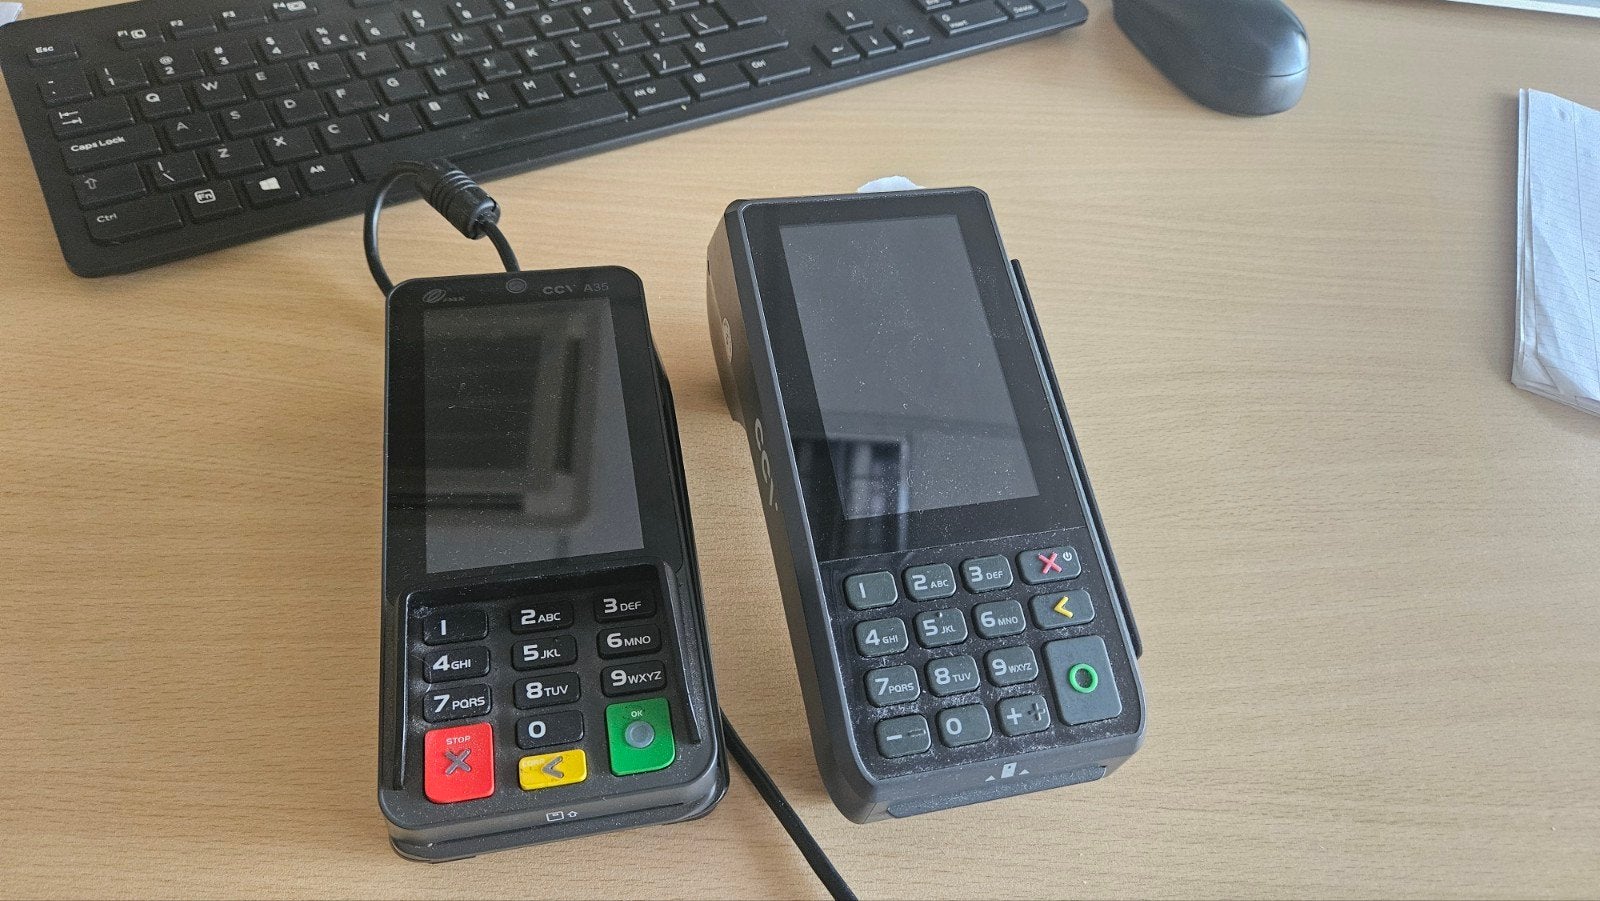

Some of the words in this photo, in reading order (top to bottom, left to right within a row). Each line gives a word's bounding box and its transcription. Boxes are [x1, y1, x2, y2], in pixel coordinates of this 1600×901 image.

[540, 14, 553, 24] O
[451, 32, 464, 43] U
[405, 41, 416, 51] Y
[569, 39, 581, 48] L
[356, 51, 367, 61] T
[526, 47, 538, 57] K
[165, 66, 175, 74] 2
[307, 61, 320, 71] R
[255, 71, 267, 81] E
[202, 80, 218, 91] W
[523, 80, 537, 90] M
[145, 93, 161, 102] Q
[283, 99, 297, 109] D
[230, 110, 241, 119] S
[378, 112, 390, 123] V
[177, 121, 189, 131] A
[327, 123, 340, 134] C
[71, 142, 98, 152] Caps
[99, 135, 126, 147] Lock
[273, 136, 287, 147] X
[218, 148, 231, 158] Z
[96, 212, 118, 223] Ctrl
[446, 735, 472, 746] STOP
